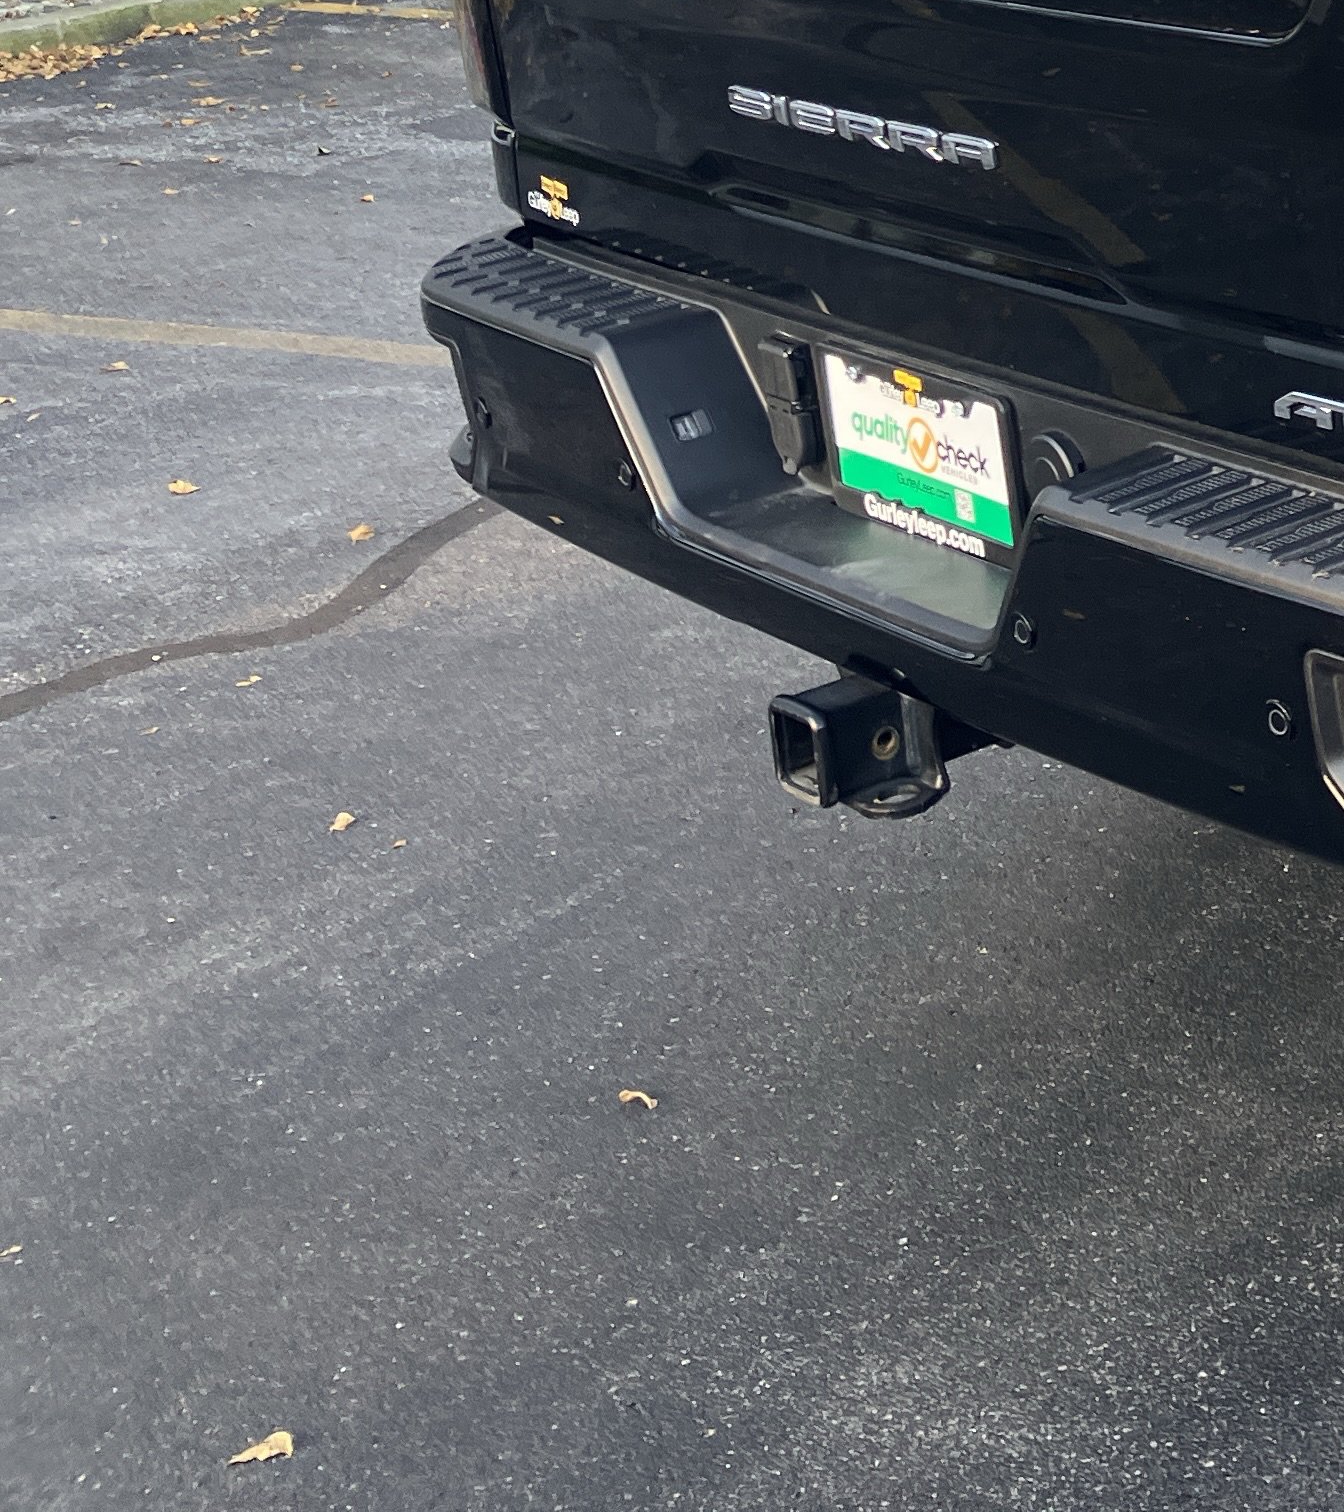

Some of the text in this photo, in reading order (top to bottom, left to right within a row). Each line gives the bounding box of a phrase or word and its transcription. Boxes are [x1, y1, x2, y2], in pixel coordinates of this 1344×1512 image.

[727, 84, 999, 172] SIERRA
[851, 411, 990, 479] quality check
[940, 464, 979, 486] VEHICLES
